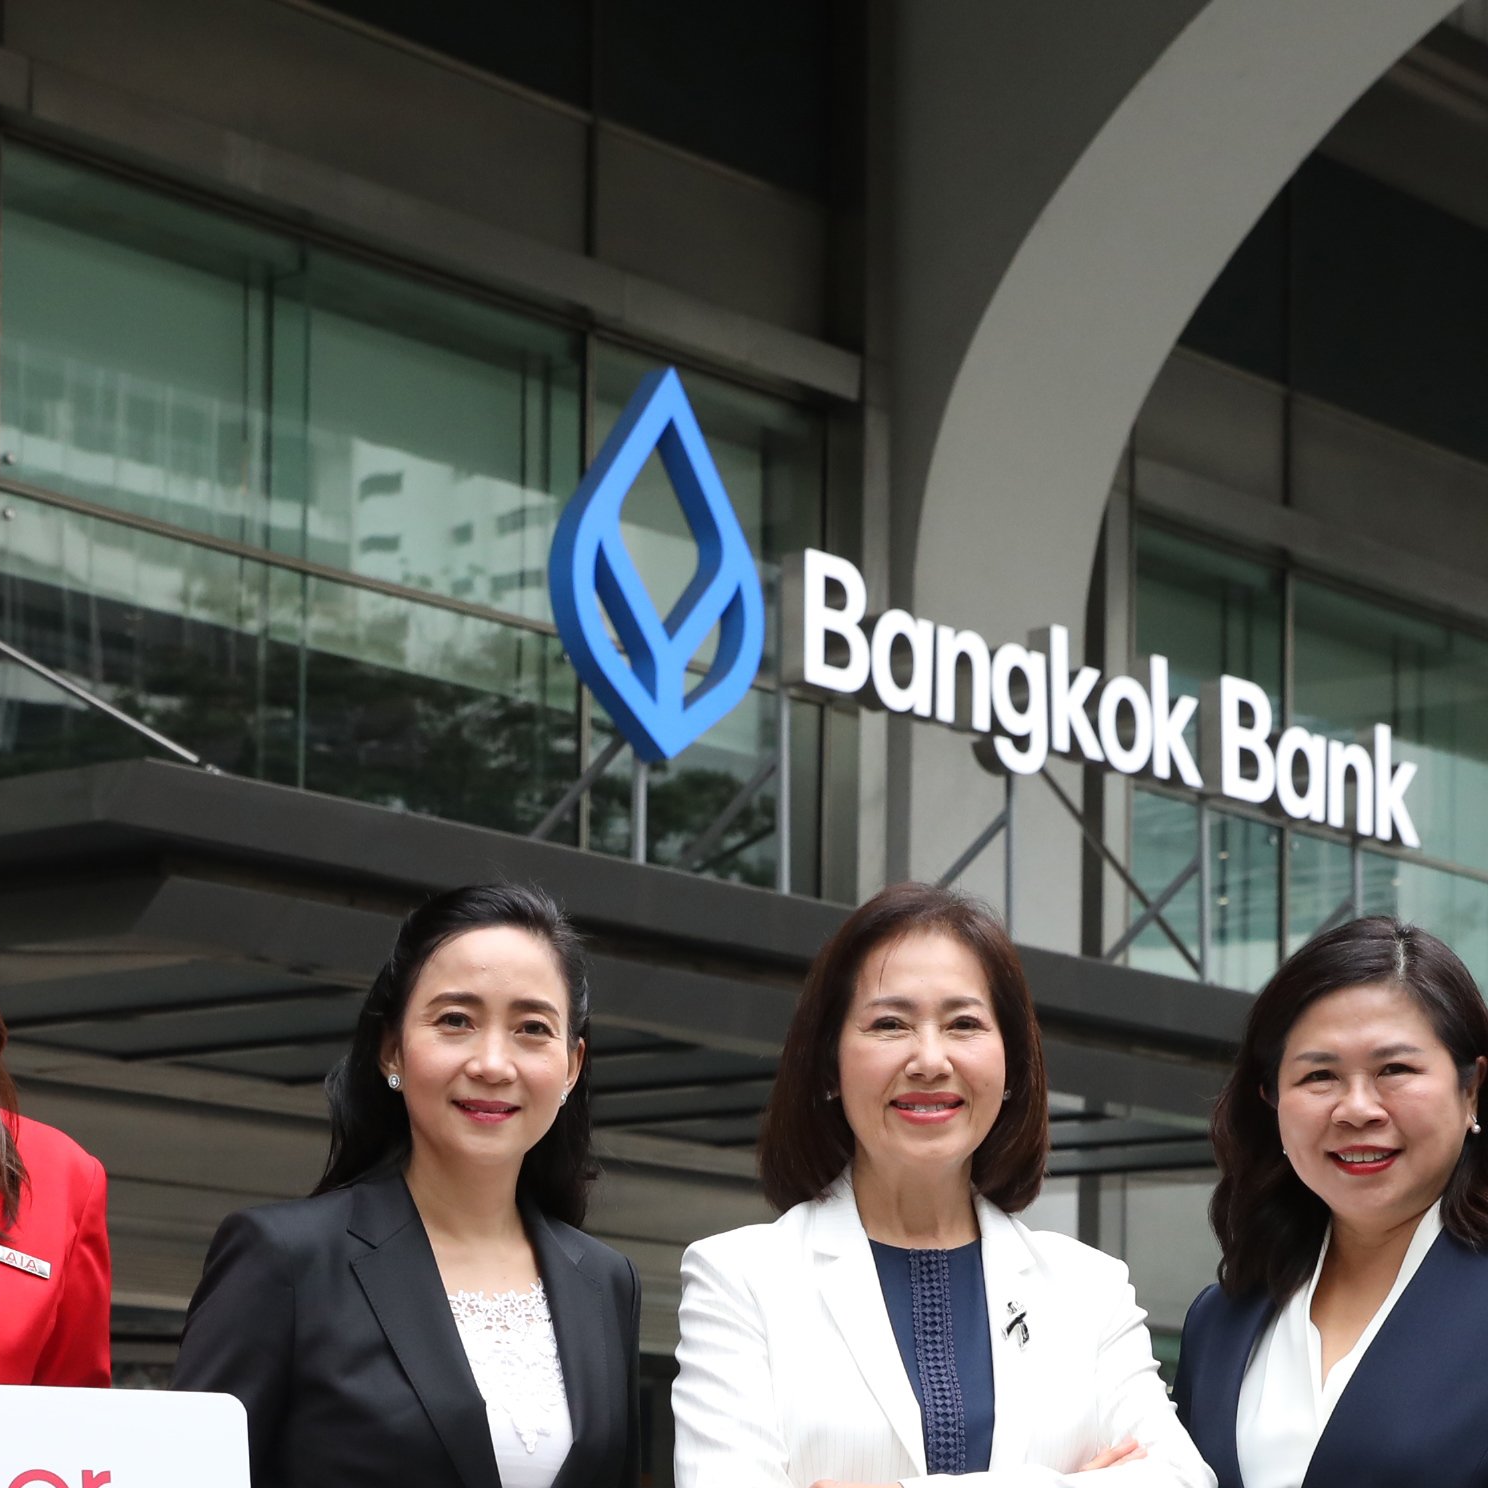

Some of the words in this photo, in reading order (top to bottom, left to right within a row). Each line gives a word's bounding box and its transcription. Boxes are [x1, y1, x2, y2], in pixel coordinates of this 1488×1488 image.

[804, 549, 1203, 788] Bangkok
[1221, 675, 1420, 848] Bank
[5, 1251, 38, 1272] AIA
